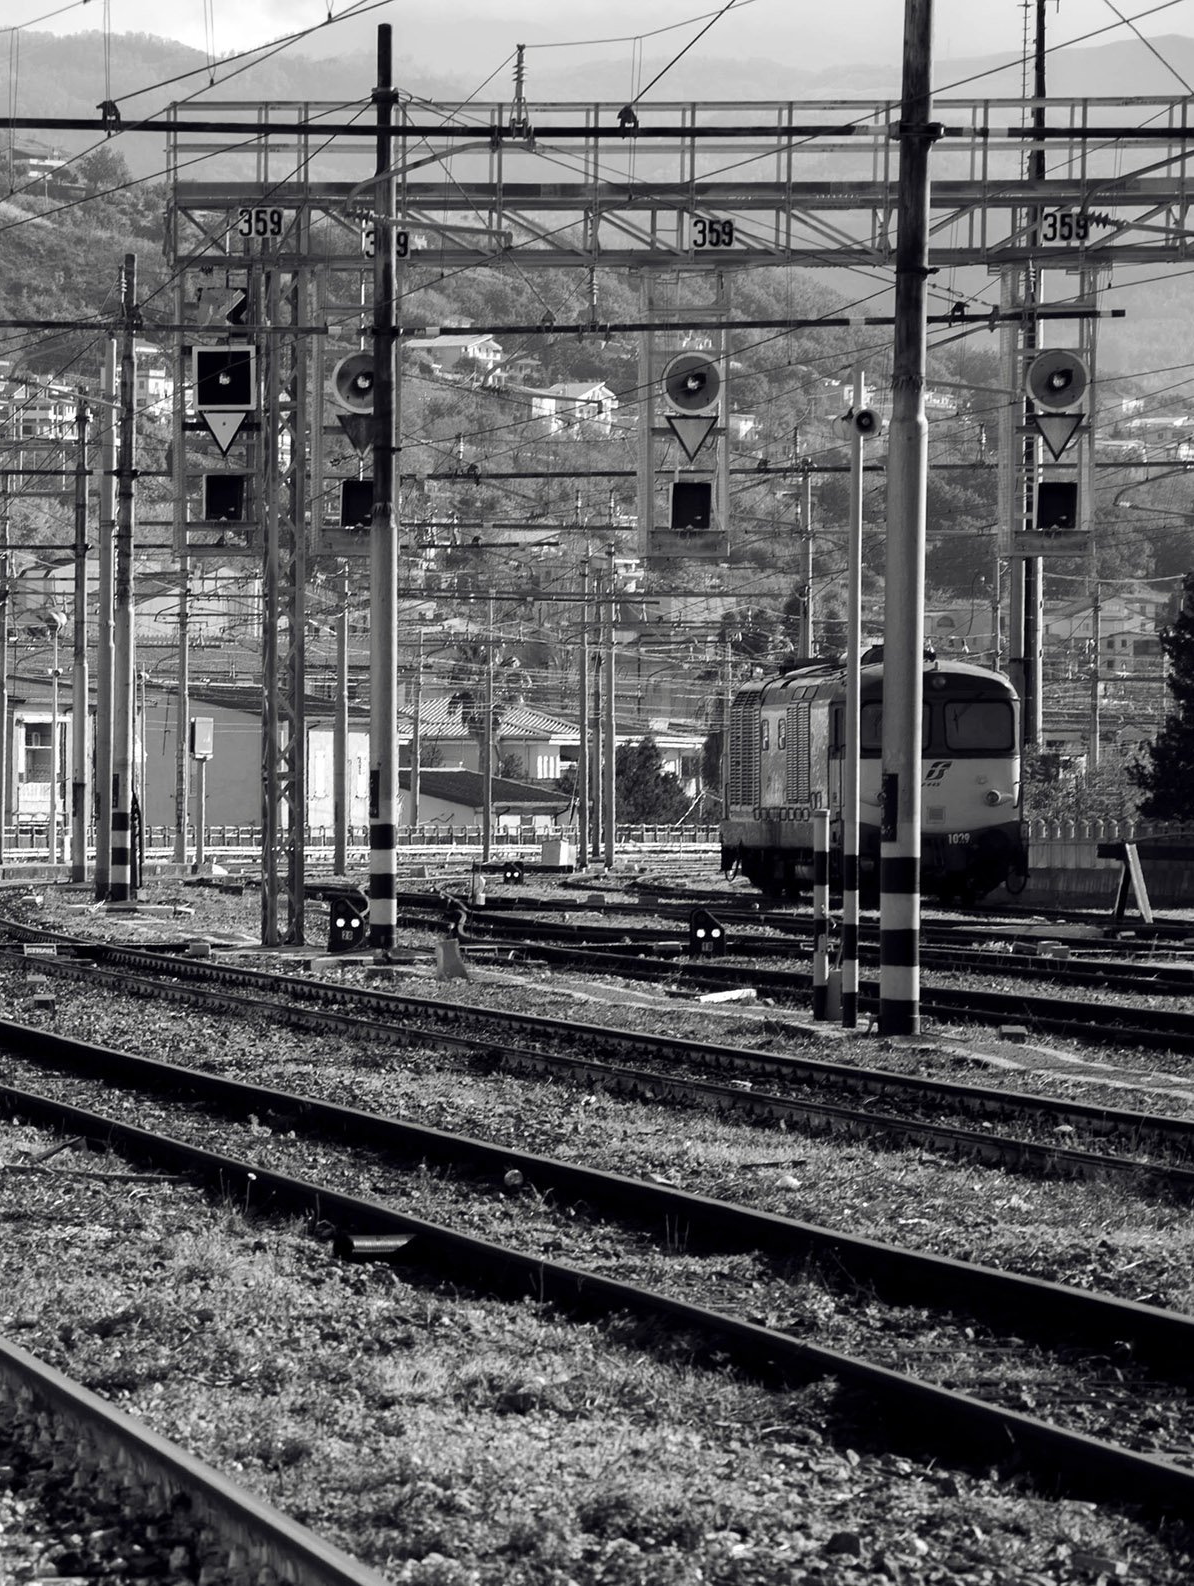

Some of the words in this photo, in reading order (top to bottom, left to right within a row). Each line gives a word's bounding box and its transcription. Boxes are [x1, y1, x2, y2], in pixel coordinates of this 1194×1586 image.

[239, 209, 282, 237] 359
[693, 219, 733, 247] 359
[1043, 213, 1088, 241] 359
[365, 231, 408, 258] 39
